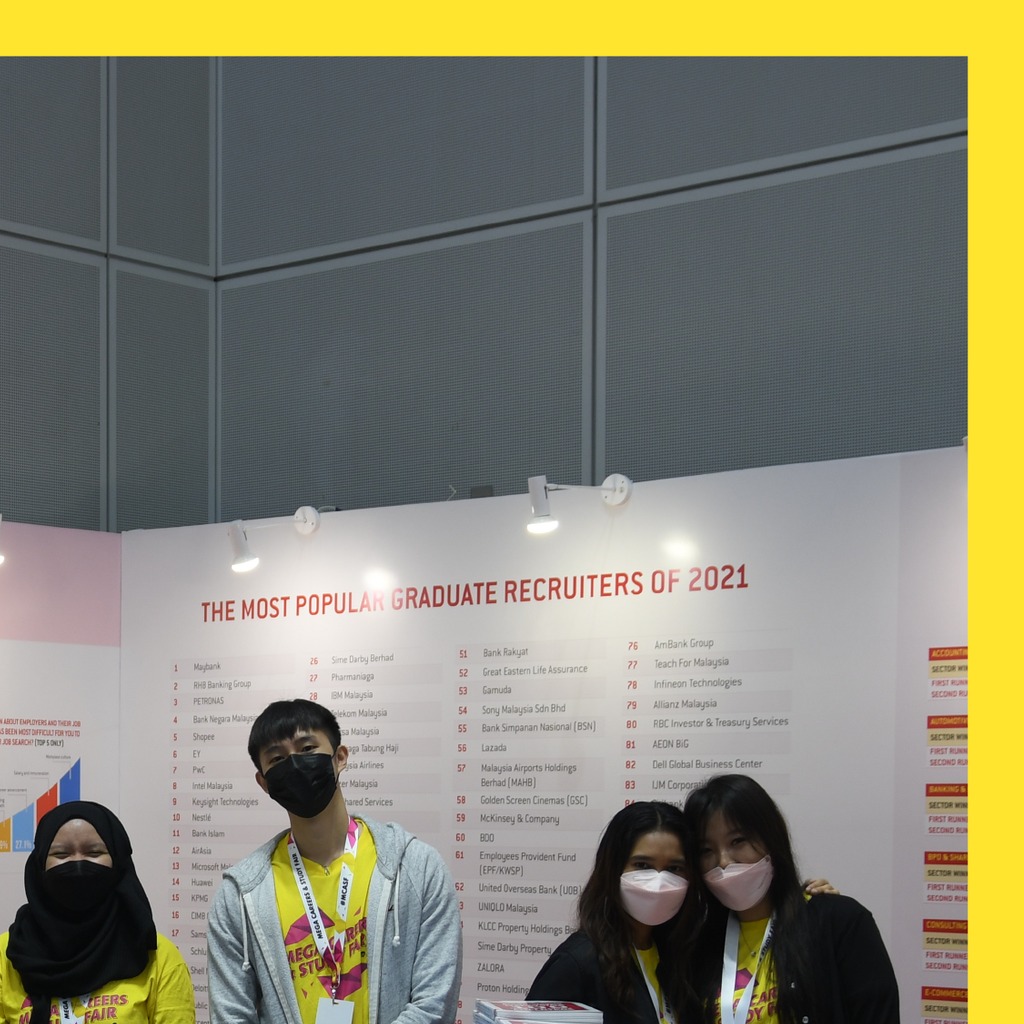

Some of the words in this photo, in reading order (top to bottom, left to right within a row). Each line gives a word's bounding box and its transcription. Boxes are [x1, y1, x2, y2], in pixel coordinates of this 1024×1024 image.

[201, 600, 235, 622] THE
[241, 596, 290, 620] MOST
[296, 590, 384, 616] POPULAR
[391, 581, 497, 611] GRADUATE
[504, 571, 643, 603] RECRUITERS
[651, 569, 681, 594] OF
[688, 563, 749, 592] 2021
[654, 639, 688, 649] AmBank
[690, 638, 714, 650] Group
[459, 649, 467, 658] 51
[483, 648, 502, 657] Bank
[503, 647, 528, 658] Rakyat
[654, 658, 675, 668] Teach
[676, 658, 691, 667] For
[693, 656, 729, 668] Malaysia
[483, 667, 501, 677] Great
[503, 666, 531, 676] Eastern
[532, 665, 547, 674] Life
[548, 664, 588, 674] Assurance
[931, 665, 957, 673] SECTOR
[331, 672, 374, 683] Pharmaniaga
[931, 679, 949, 687] FIRST
[653, 718, 669, 728] RBC
[671, 718, 704, 728] Investor
[705, 718, 713, 727] &
[714, 717, 750, 729] Treasury
[752, 716, 789, 727] Services
[193, 733, 215, 743] Shopee
[480, 814, 515, 825] McKinsey
[517, 815, 523, 823] &
[525, 814, 560, 825] Company
[480, 852, 519, 863] Employees
[521, 852, 555, 862] Provident
[558, 853, 576, 862] Fund
[479, 865, 524, 877] (EPF/KWSP)
[340, 878, 349, 906] #MCASF
[84, 1007, 118, 1024] FAIR
